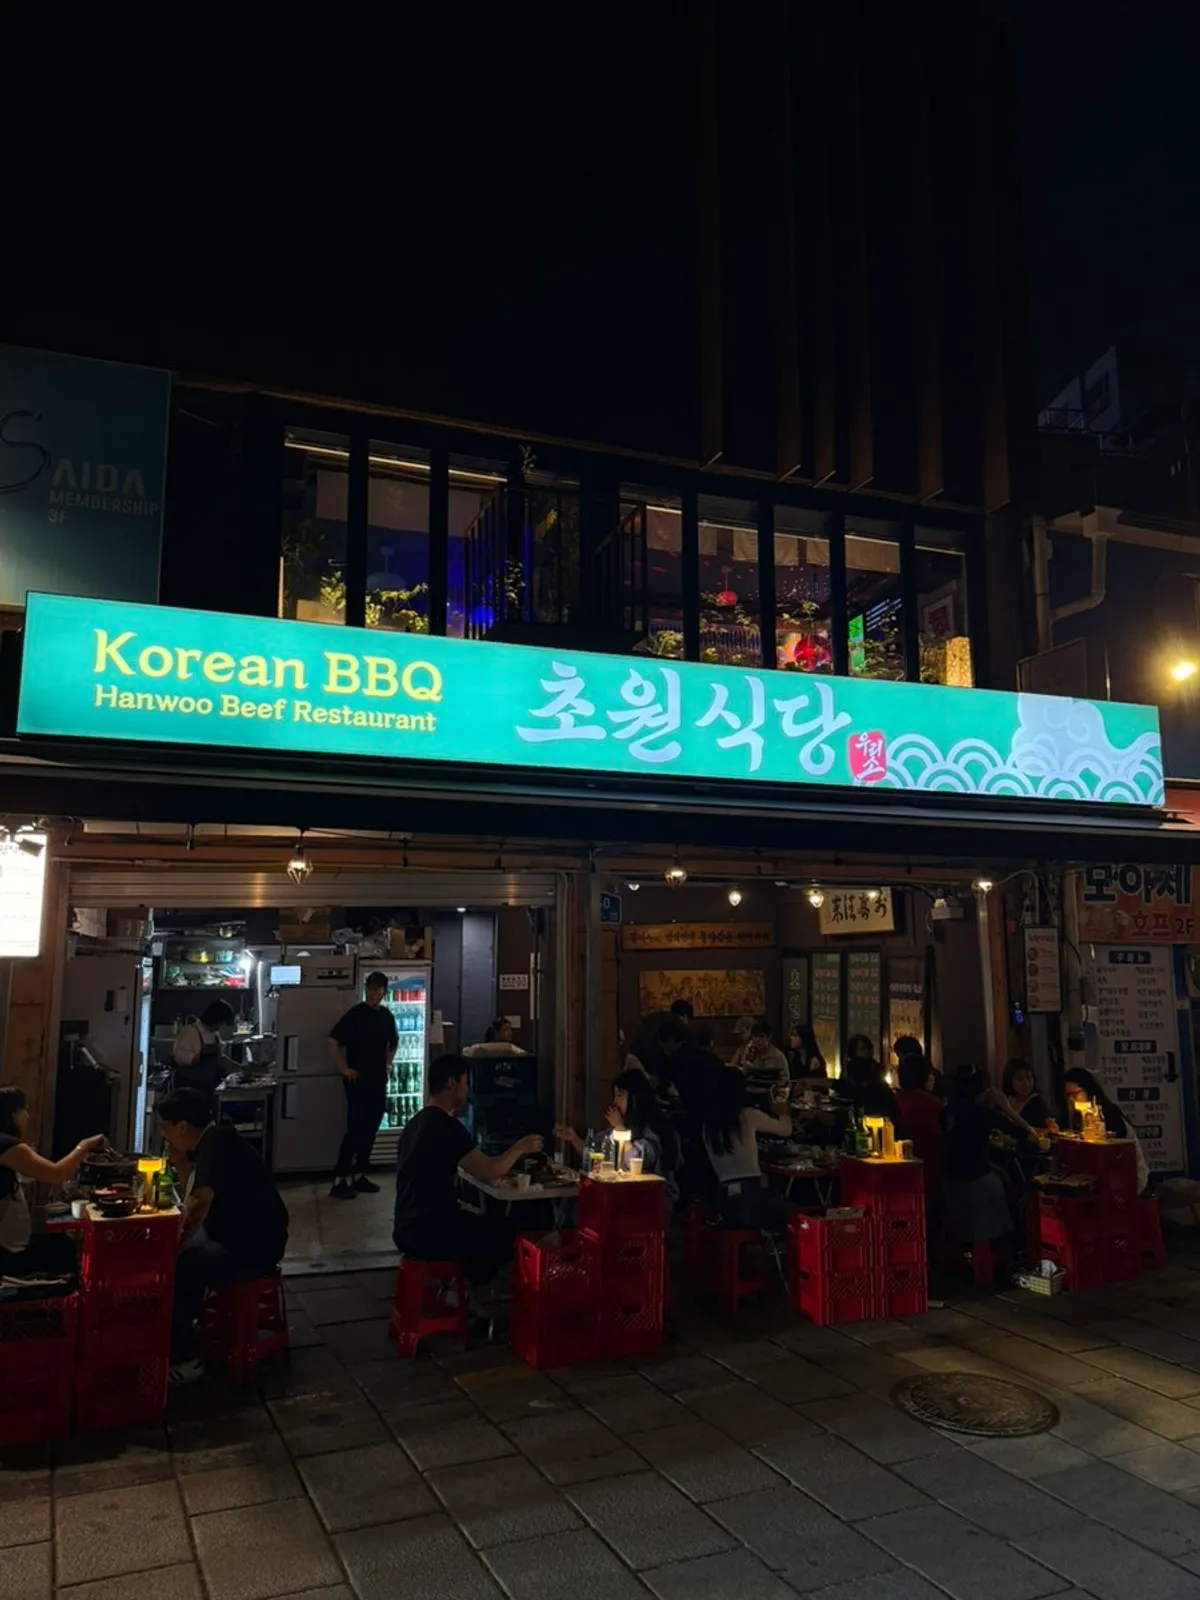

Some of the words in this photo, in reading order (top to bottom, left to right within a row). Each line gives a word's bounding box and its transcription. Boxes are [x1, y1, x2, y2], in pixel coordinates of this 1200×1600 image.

[50, 489, 160, 518] MEMBERSHIP
[93, 629, 308, 690] Korean
[322, 651, 443, 703] BBQ
[95, 683, 213, 715] Hanwoo
[220, 694, 287, 720] Beef
[293, 700, 437, 732] Restaurant
[515, 661, 852, 775] 초원식당
[1175, 917, 1194, 934] 2F
